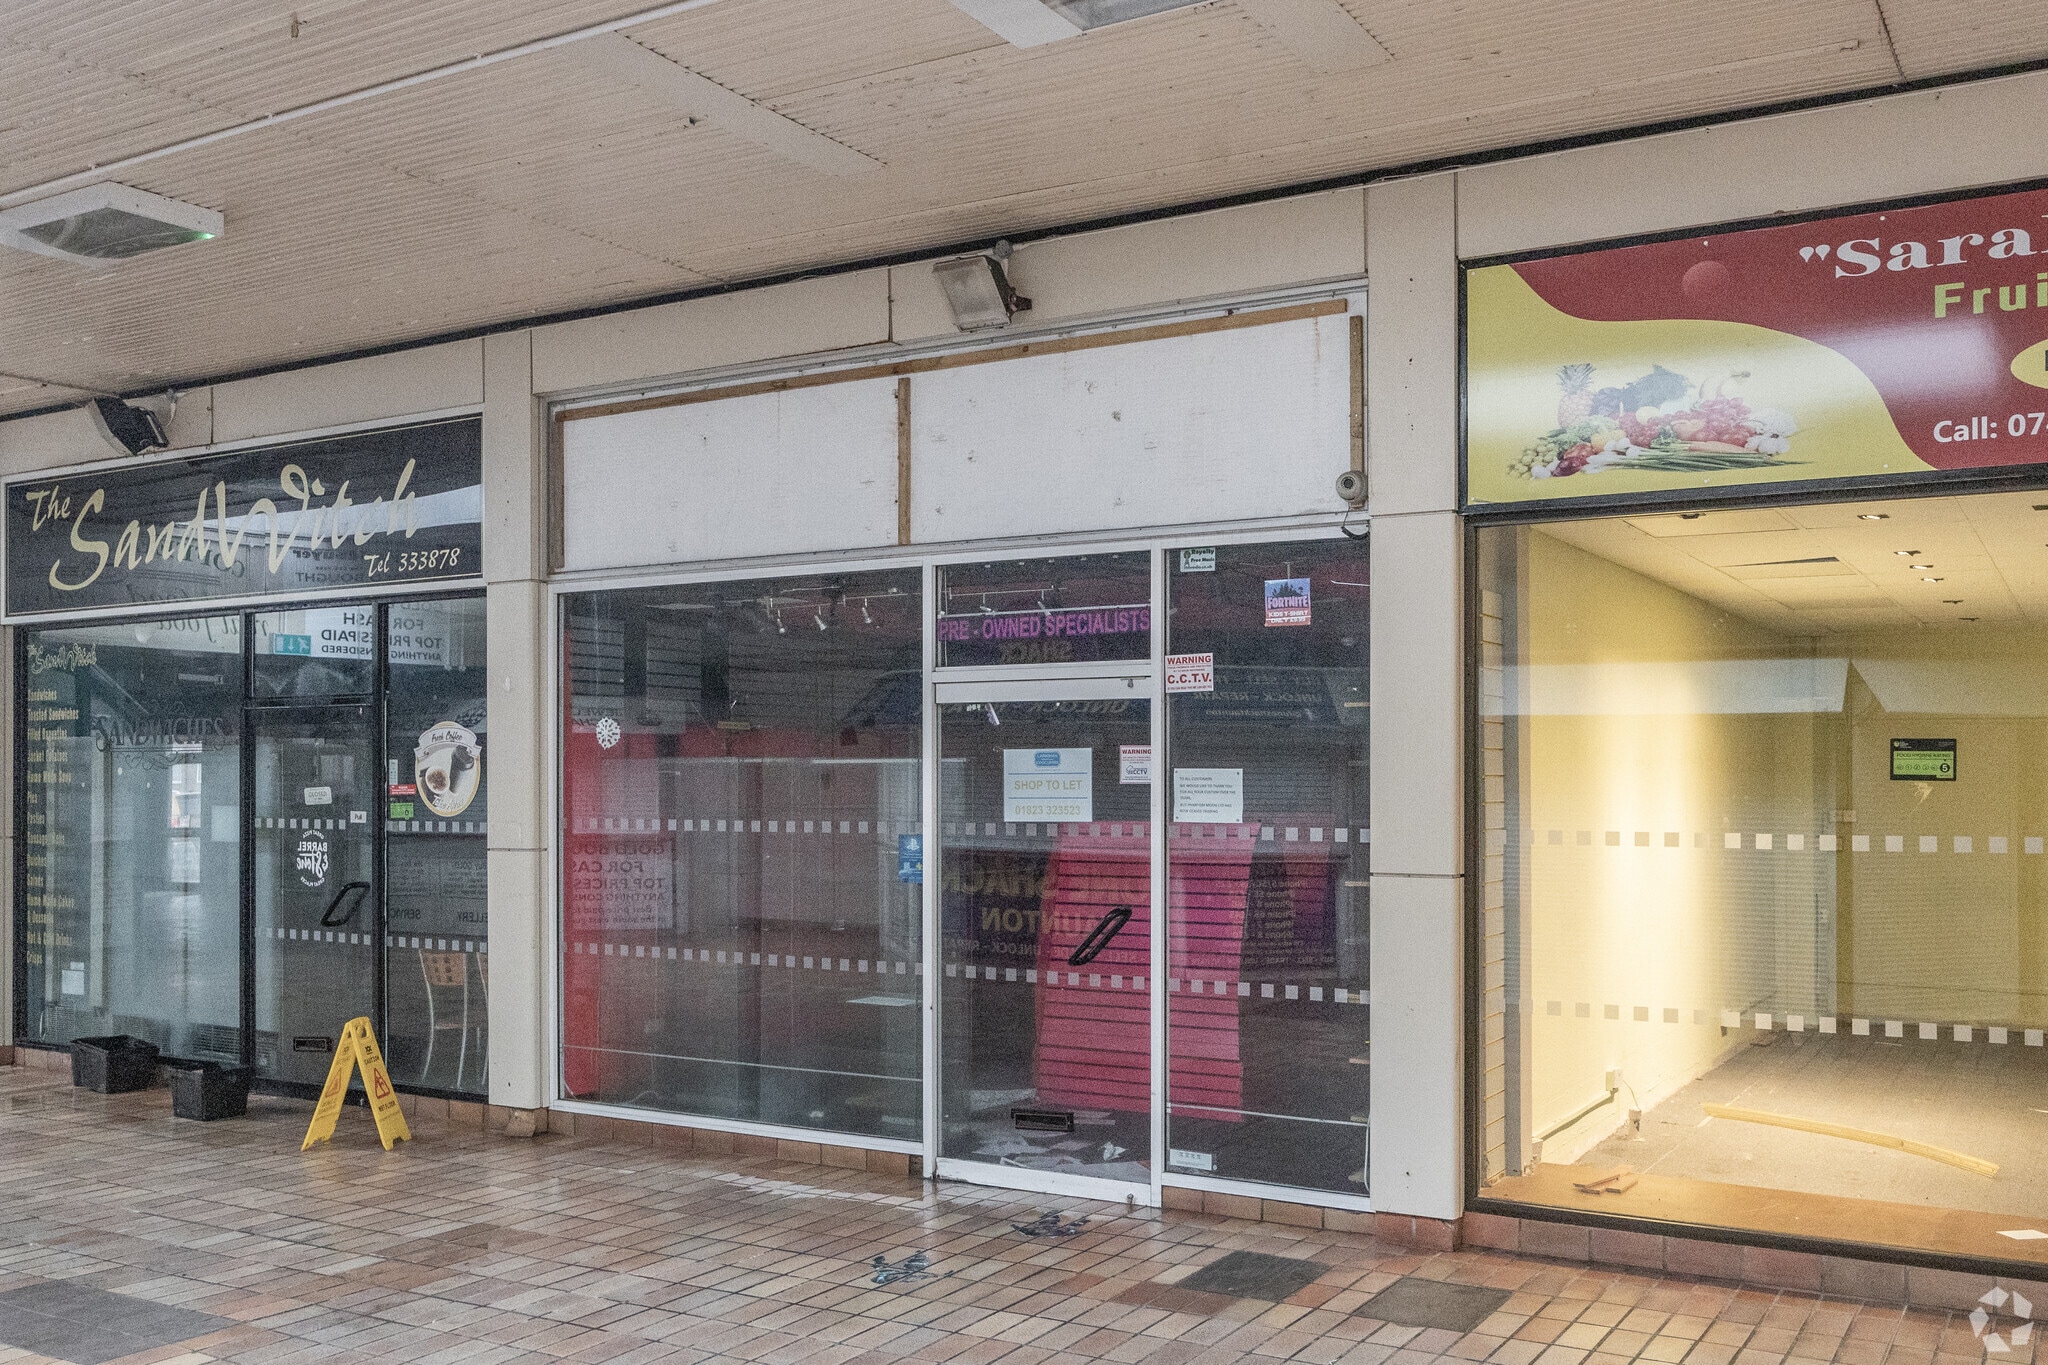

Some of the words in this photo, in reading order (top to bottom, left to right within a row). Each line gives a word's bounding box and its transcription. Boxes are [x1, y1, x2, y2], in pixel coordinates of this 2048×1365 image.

[1799, 215, 2048, 279] "Sara
[1933, 416, 1998, 443] Call:
[2007, 411, 2048, 437] 07
[26, 484, 71, 531] The
[363, 552, 391, 577] Tel
[397, 546, 460, 572] 333878
[1268, 595, 1308, 610] FORTNITE
[938, 619, 970, 641] PRE
[982, 616, 1041, 638] OWNED
[1044, 609, 1150, 636] SPECIALISTS
[1167, 655, 1211, 664] WARNING
[1167, 673, 1212, 684] C.C.T.V.
[92, 716, 225, 752] SANDWICHES
[1014, 780, 1043, 790] SHOP
[1046, 780, 1060, 790] TO
[1063, 779, 1083, 790] LET
[1015, 805, 1044, 815] 01823
[1046, 805, 1081, 816] 323523
